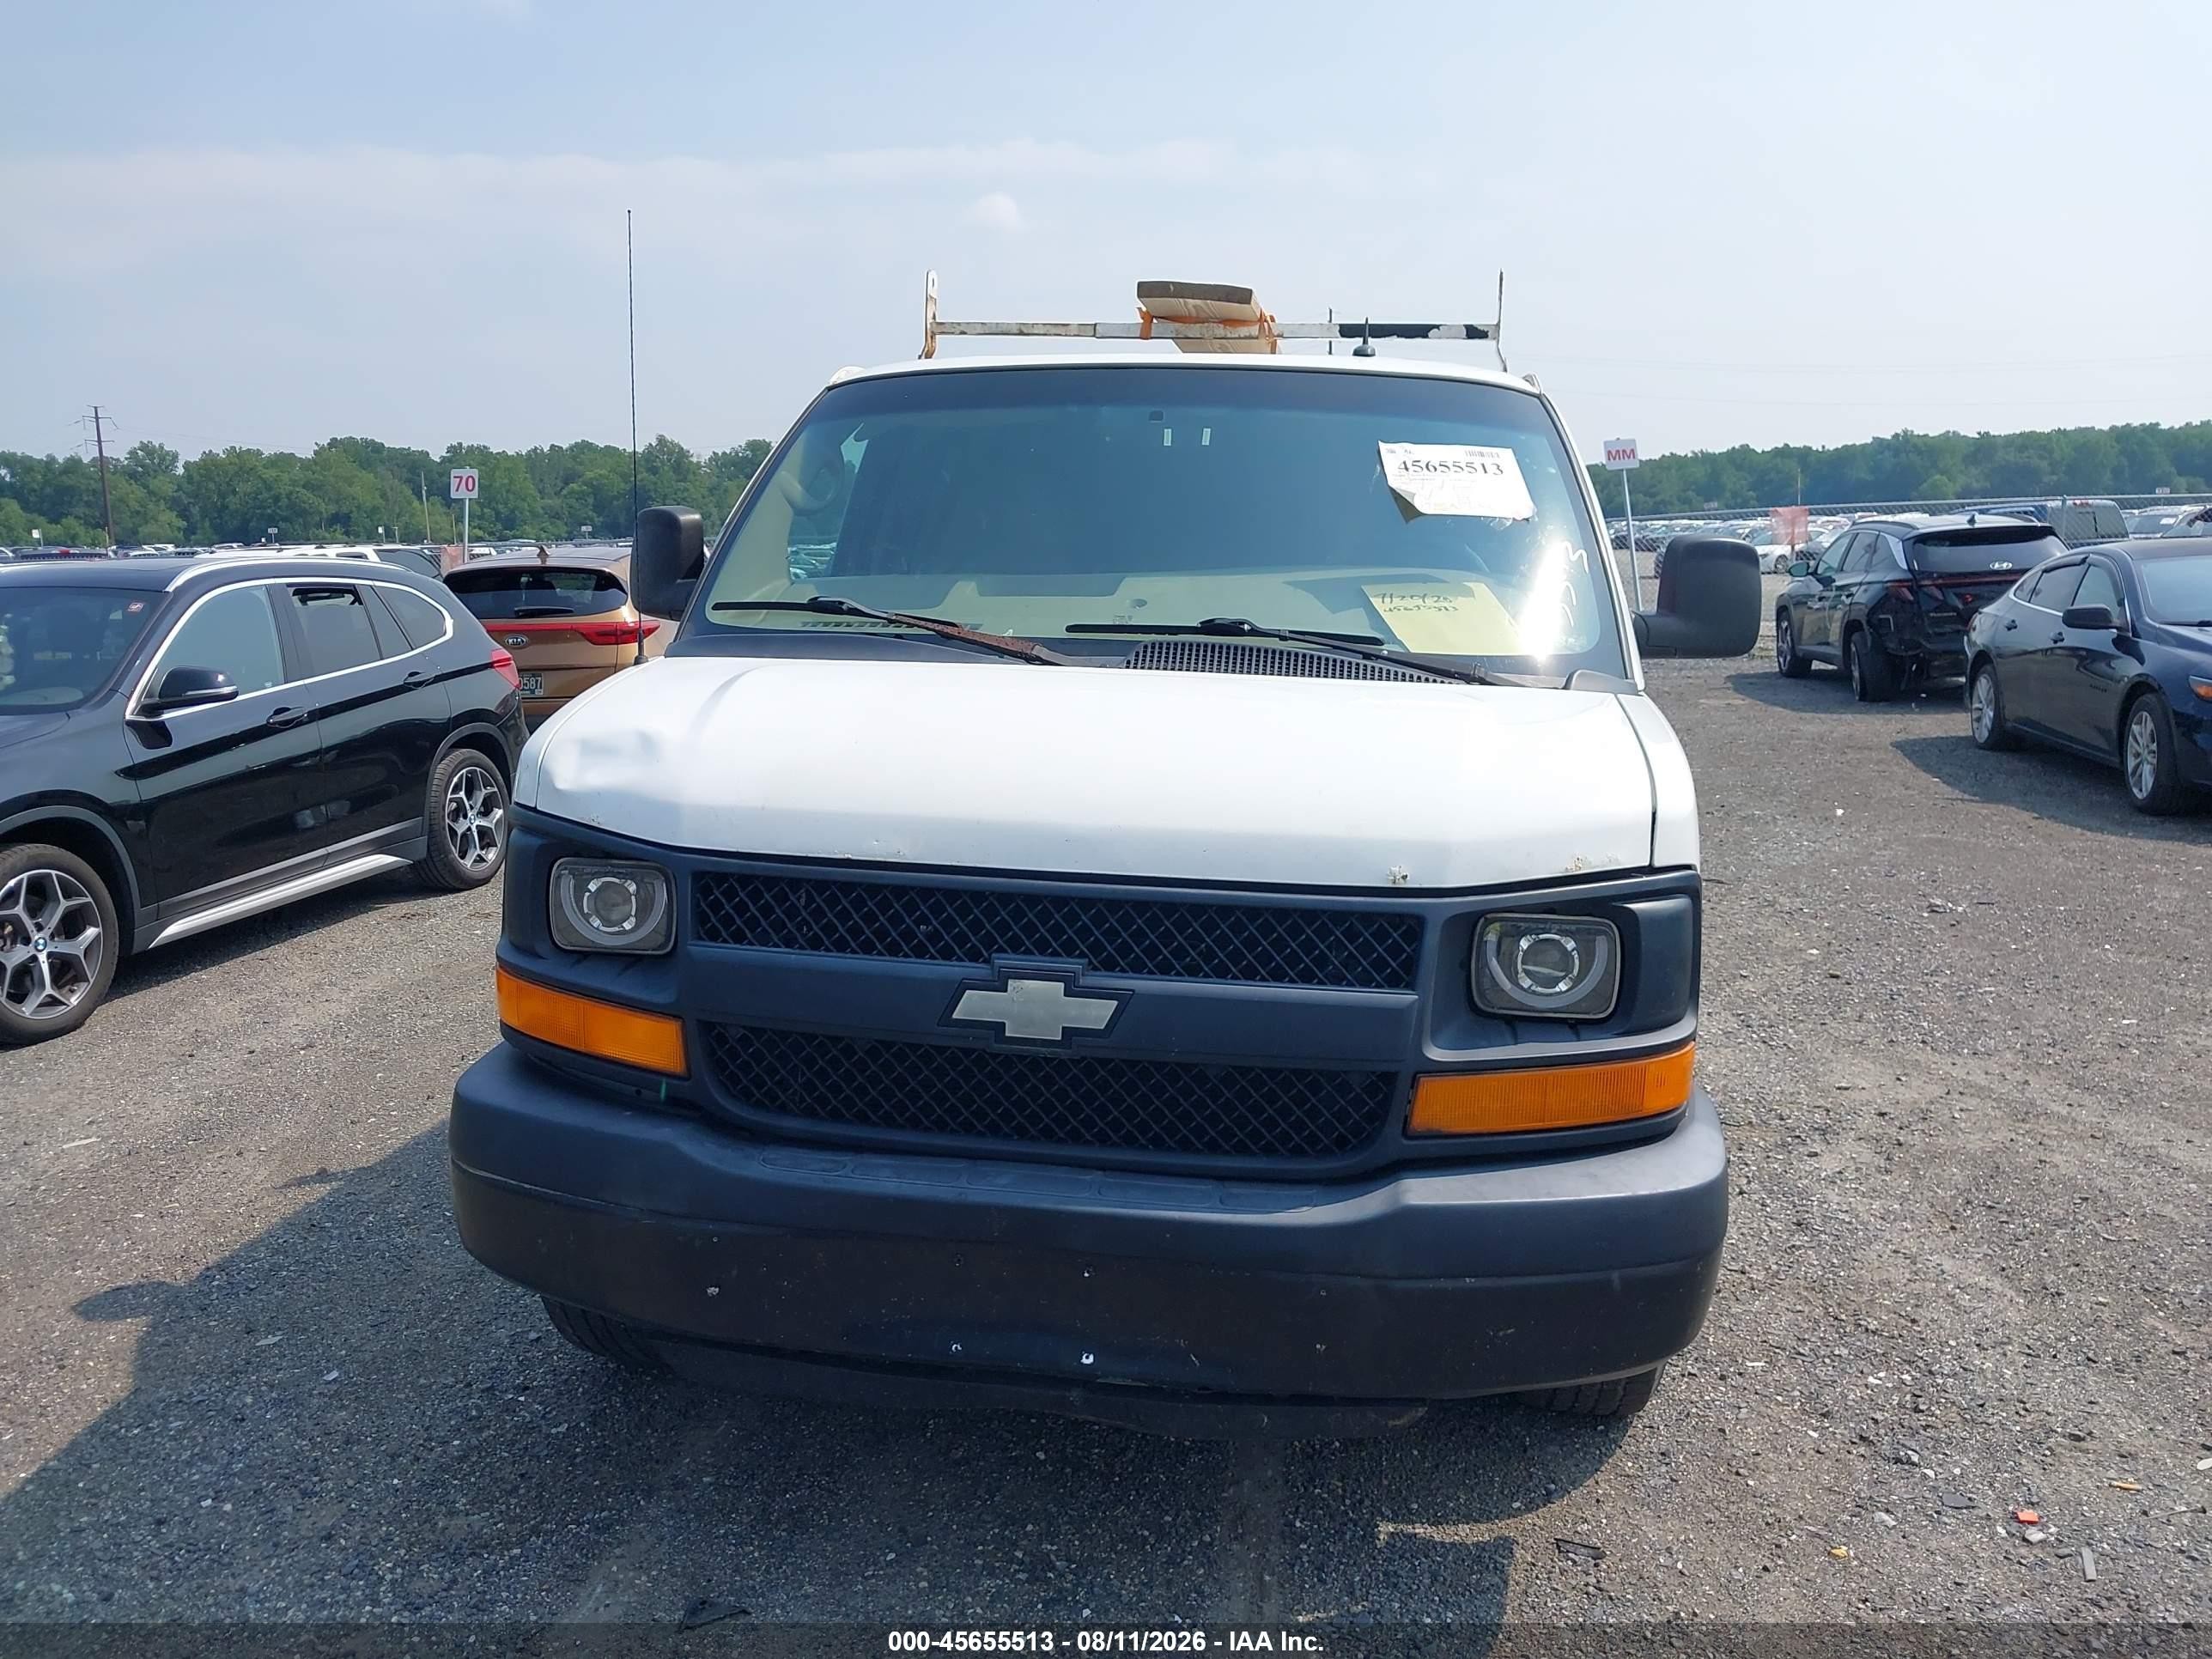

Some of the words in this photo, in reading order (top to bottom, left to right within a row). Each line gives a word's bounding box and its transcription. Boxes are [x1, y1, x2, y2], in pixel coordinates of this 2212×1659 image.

[1607, 448, 1636, 461] MM
[1397, 459, 1504, 476] 45655513
[453, 475, 476, 493] 70
